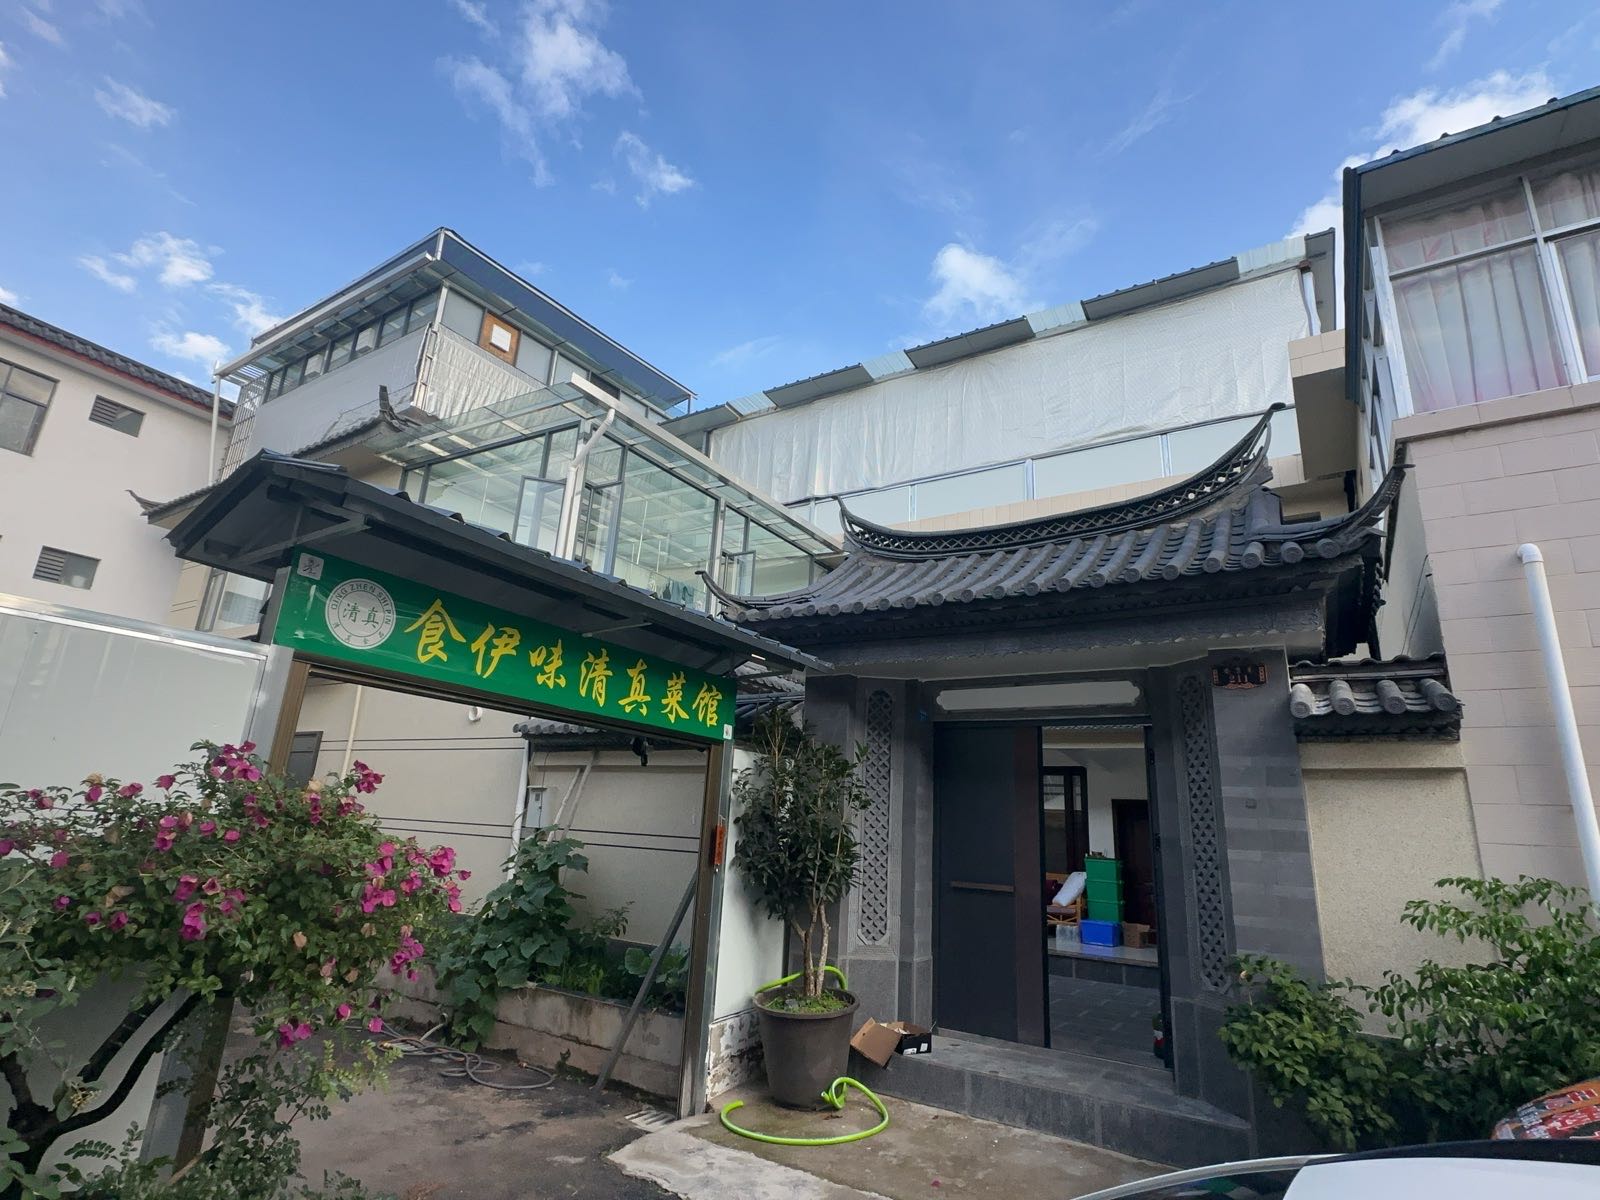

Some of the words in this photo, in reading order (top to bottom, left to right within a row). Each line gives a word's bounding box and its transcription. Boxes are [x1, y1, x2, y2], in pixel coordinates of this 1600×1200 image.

[331, 587, 347, 610] QING
[350, 583, 376, 592] ZHEN
[343, 602, 379, 629] 清真
[404, 599, 723, 728] 食伊味清真菜馆
